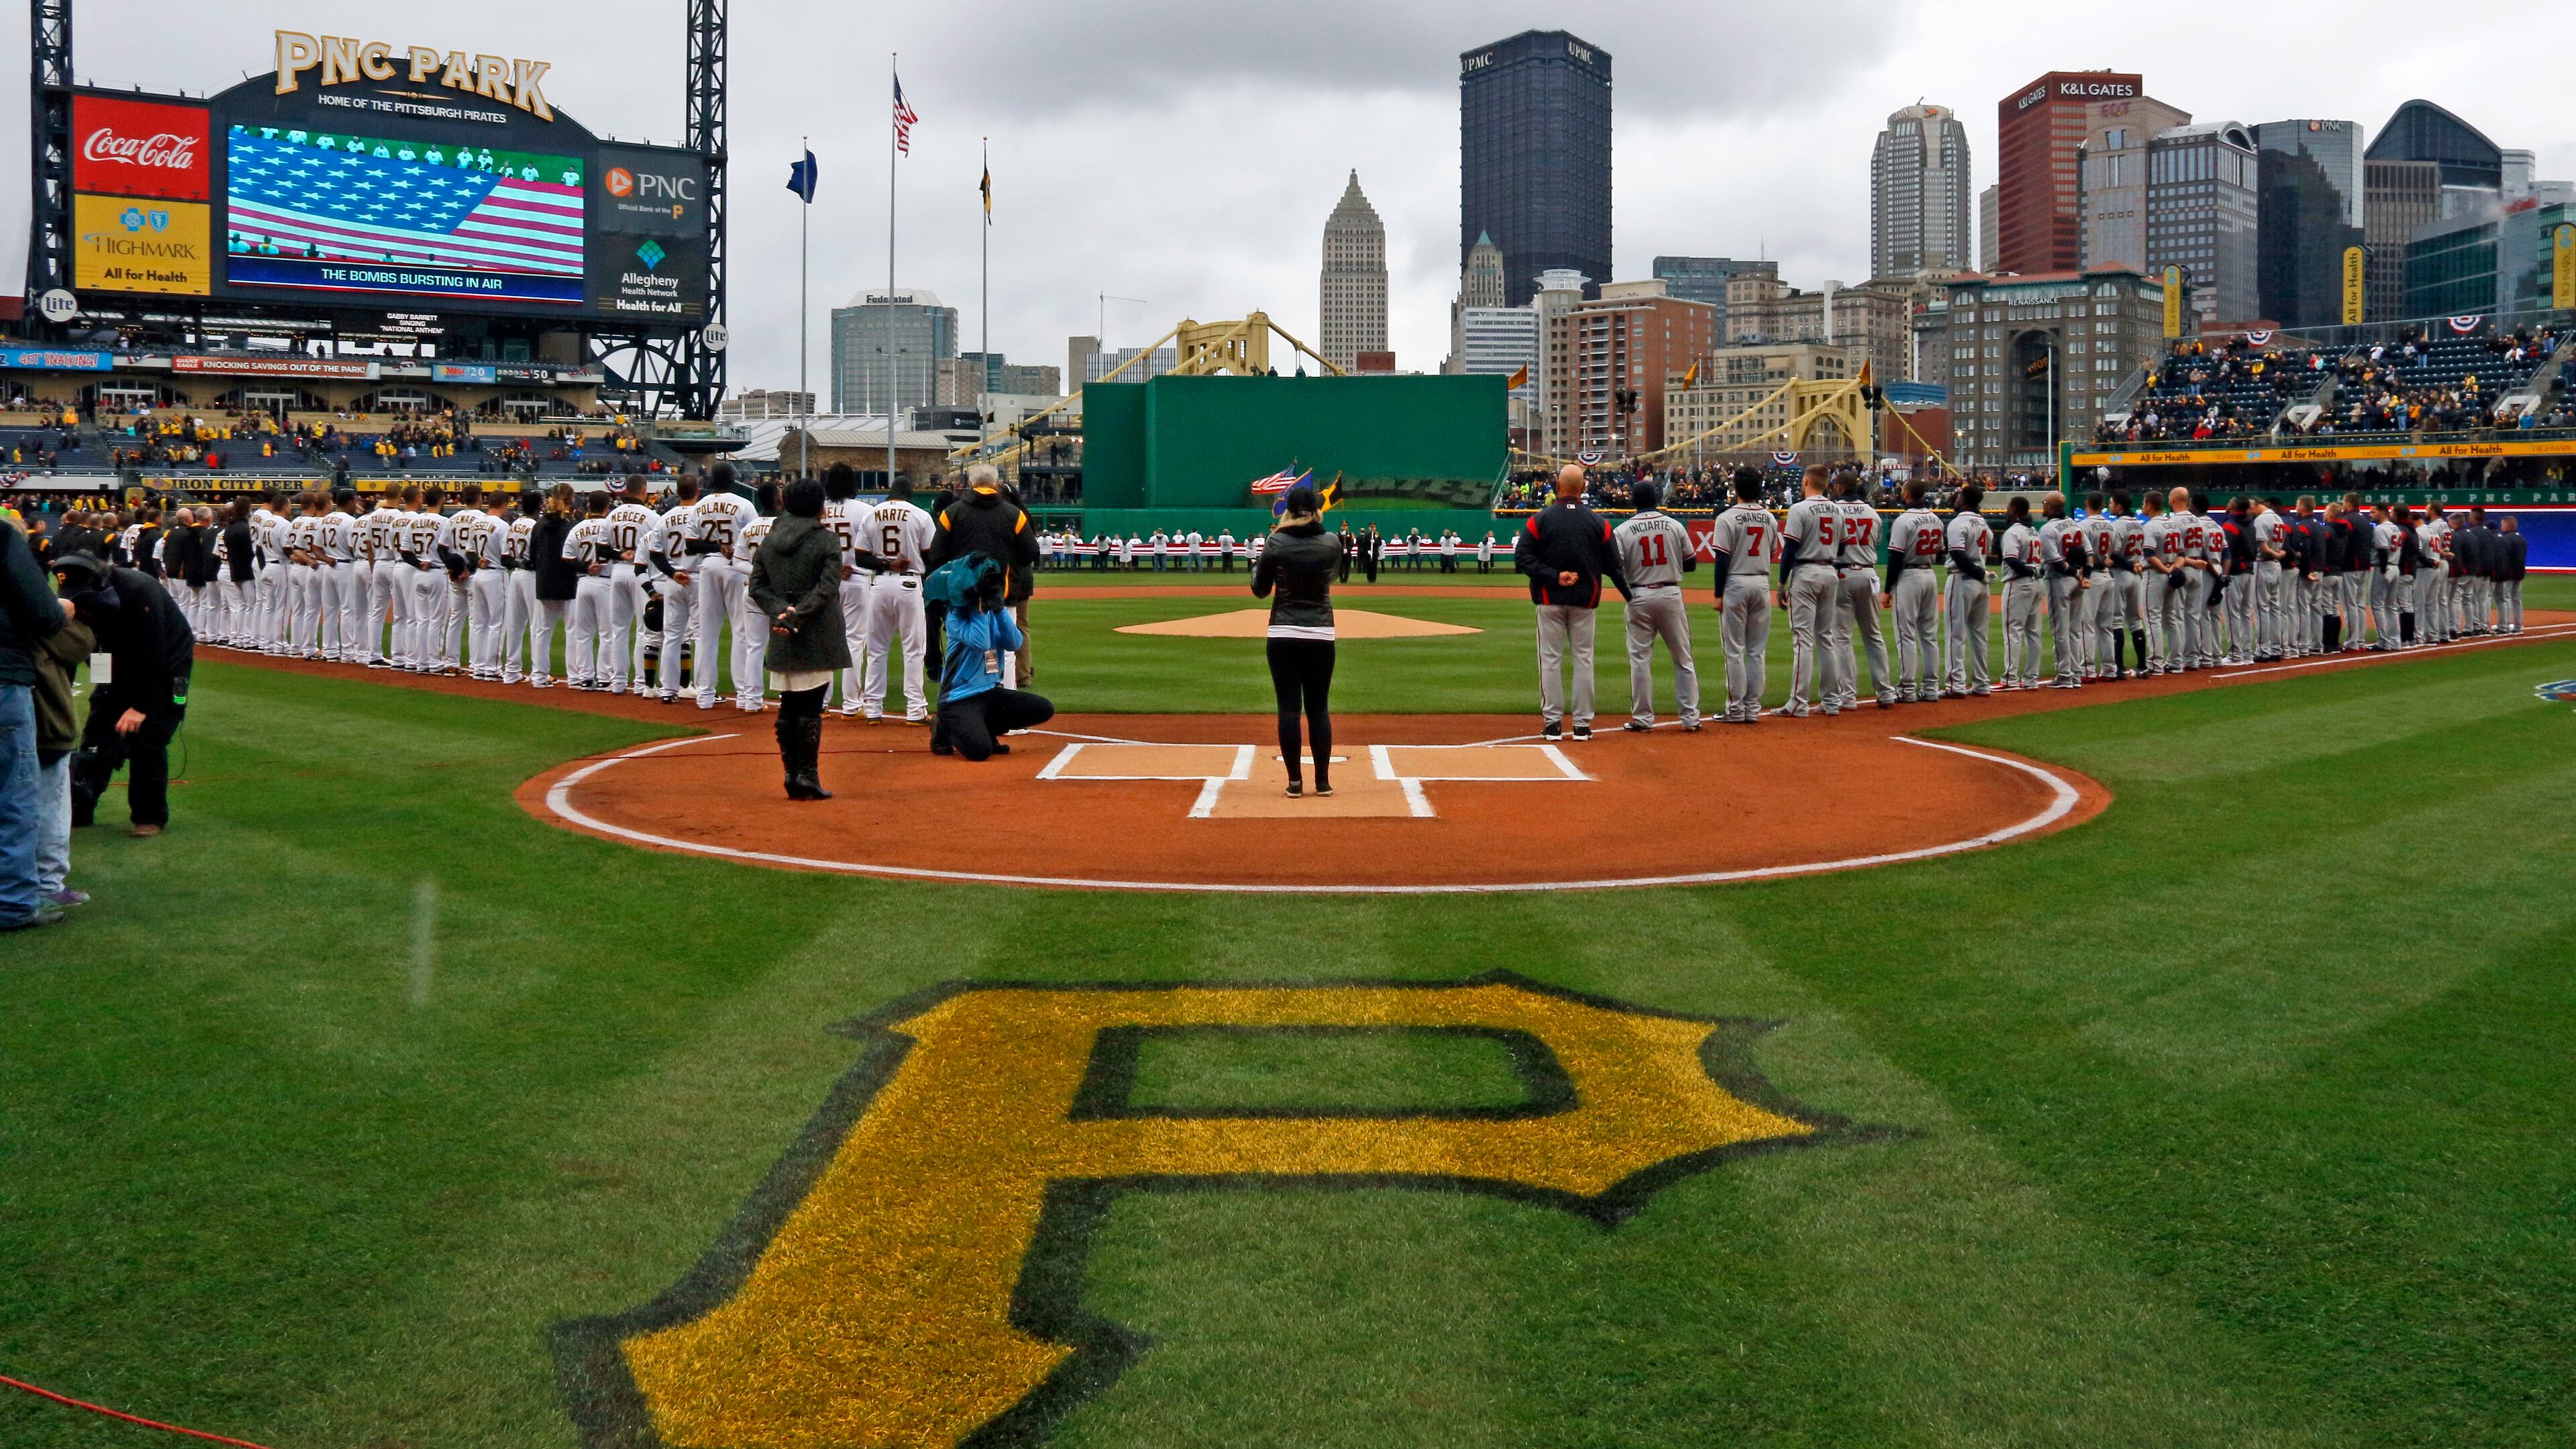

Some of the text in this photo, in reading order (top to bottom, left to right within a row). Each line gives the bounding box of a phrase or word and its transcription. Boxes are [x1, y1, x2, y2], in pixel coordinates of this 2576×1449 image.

[1568, 42, 1593, 64] UPMC
[1461, 52, 1493, 73] UPMC
[275, 30, 553, 122] PNC PARK
[2019, 85, 2046, 110] K&L GATES
[2061, 83, 2133, 96] K&L GATES
[319, 95, 506, 123] HOME OF THE PITTSBURGH PIRATES
[2322, 121, 2343, 131] PNC
[84, 127, 200, 169] Coca-Cola
[638, 173, 695, 201] PNC
[618, 203, 638, 212] Official
[97, 236, 196, 260] HIGHMARK
[104, 268, 188, 282] All for Health
[321, 268, 502, 290] THE BOMBS BURSTING IN AIR
[621, 272, 679, 288] Allegheny
[621, 287, 678, 297] Health Network
[2349, 252, 2358, 322] All for Health
[46, 297, 74, 313] Lite
[616, 299, 682, 313] Health for All
[2008, 297, 2059, 307] RENAISSANCE
[706, 329, 726, 343] Lite
[19, 353, 42, 365] GET
[44, 352, 99, 368] SNACKING!
[203, 361, 366, 374] KNOCKING SAVINGS OUT OF THE PARK!
[470, 368, 484, 377] 20
[2294, 450, 2306, 458] for
[2308, 449, 2337, 458] Health
[2439, 443, 2502, 455] All for Health
[2165, 453, 2190, 462] Health
[171, 479, 213, 490] IRON
[219, 479, 258, 490] CITY
[2469, 494, 2511, 502] PNC
[2533, 492, 2576, 502] PAR
[696, 502, 739, 517] POLANCO
[826, 506, 845, 519] ELL
[874, 508, 911, 523] MARTE
[1809, 505, 1839, 517] FREEMAN
[1842, 506, 1865, 515] KEMP
[611, 512, 647, 525] MERCER
[665, 513, 688, 528] FREE
[1735, 513, 1770, 525] SWANSON
[575, 525, 600, 540] FRAZI
[701, 520, 733, 545] 25
[743, 525, 771, 539] McCUTC
[1629, 521, 1670, 535] INCIARTE
[1820, 517, 1833, 545] 5
[1845, 518, 1874, 545] 27
[322, 528, 336, 548] 12
[393, 532, 401, 552] 4
[412, 533, 435, 554] 57
[613, 525, 637, 551] 10
[881, 525, 902, 557] 6
[1748, 527, 1764, 557] 7
[1915, 529, 1941, 555] 22
[2098, 532, 2110, 555] 8
[2163, 532, 2181, 554] 20
[2184, 527, 2203, 548] 25
[1639, 534, 1668, 568] 11
[584, 976, 1872, 1449] P
